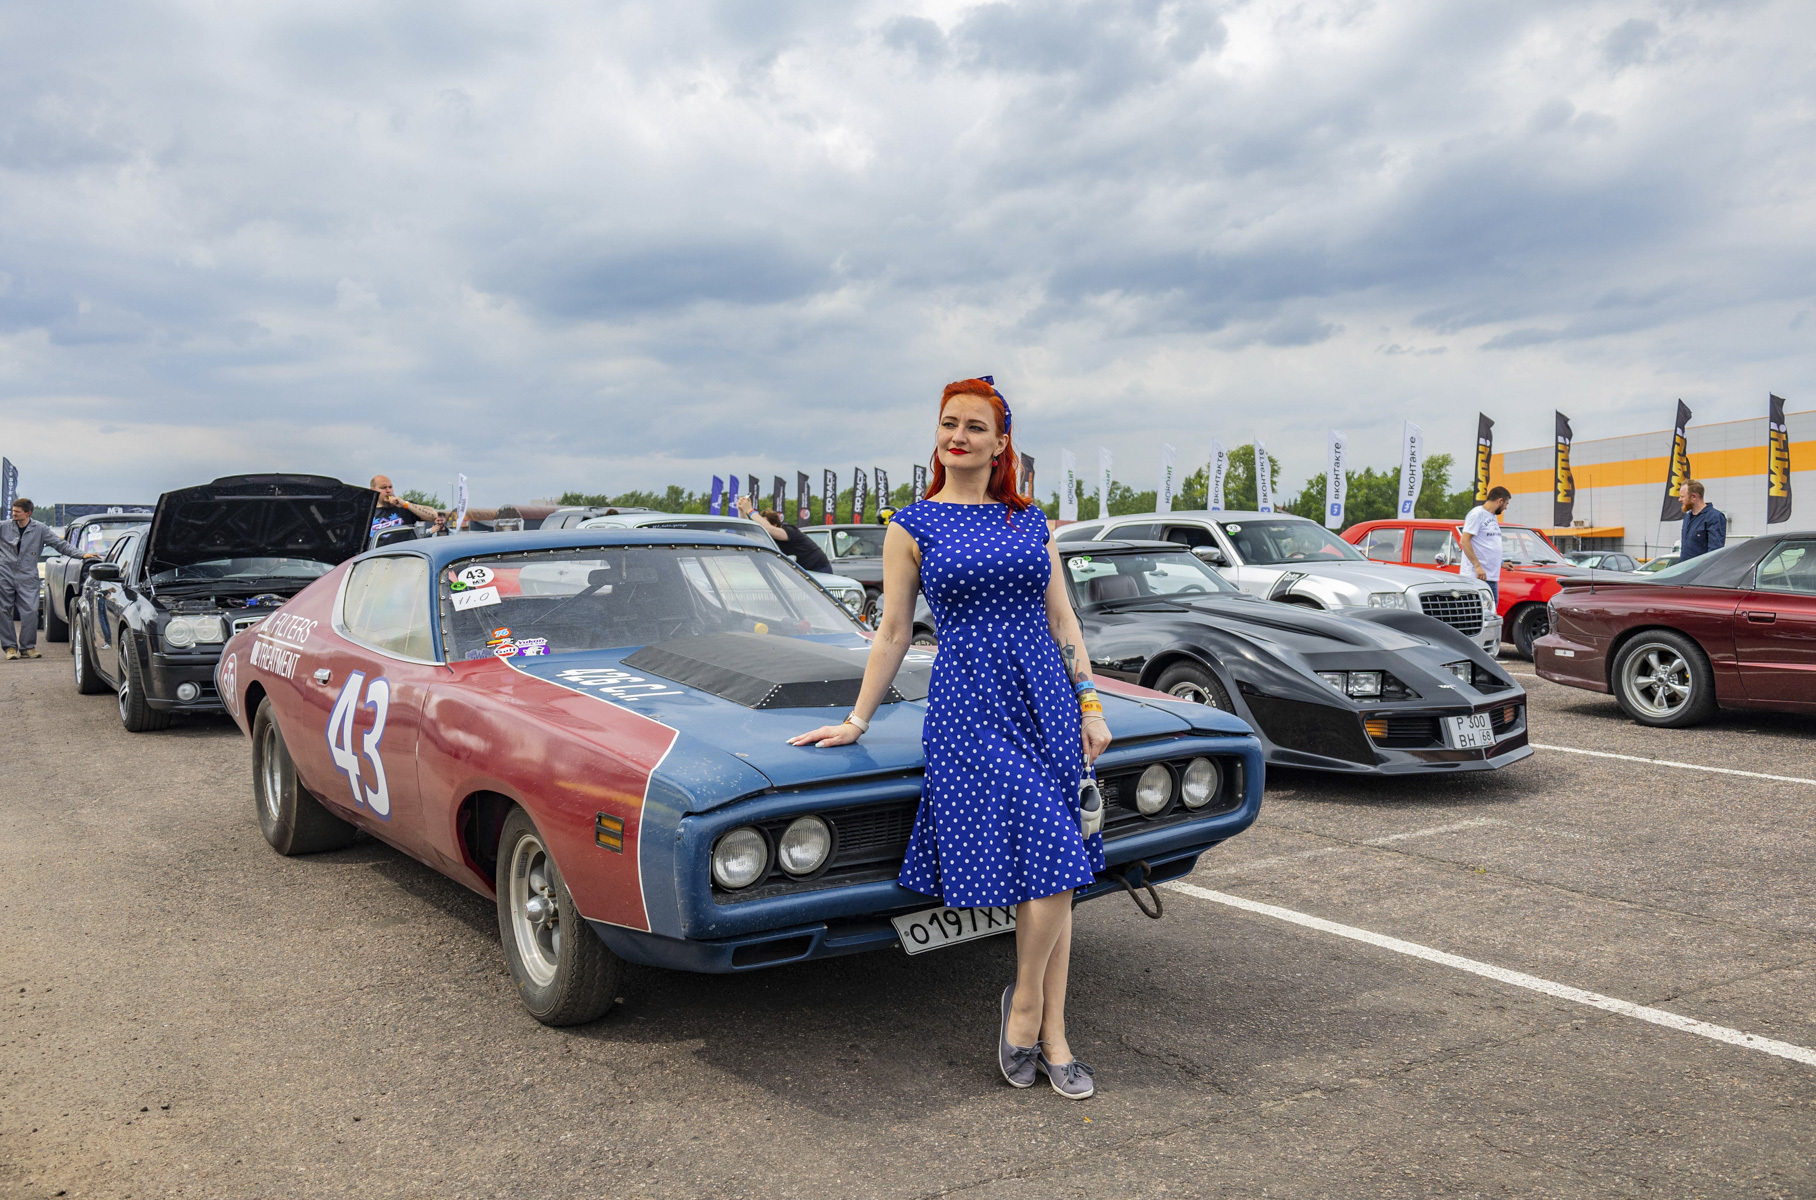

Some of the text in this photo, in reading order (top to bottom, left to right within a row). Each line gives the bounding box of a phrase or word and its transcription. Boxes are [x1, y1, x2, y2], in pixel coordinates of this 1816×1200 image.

[1071, 558, 1083, 566] 37
[466, 568, 486, 580] 43
[270, 612, 318, 643] FILTERS
[257, 642, 301, 680] TREATMENT
[1467, 715, 1486, 729] 300
[325, 669, 391, 822] 43
